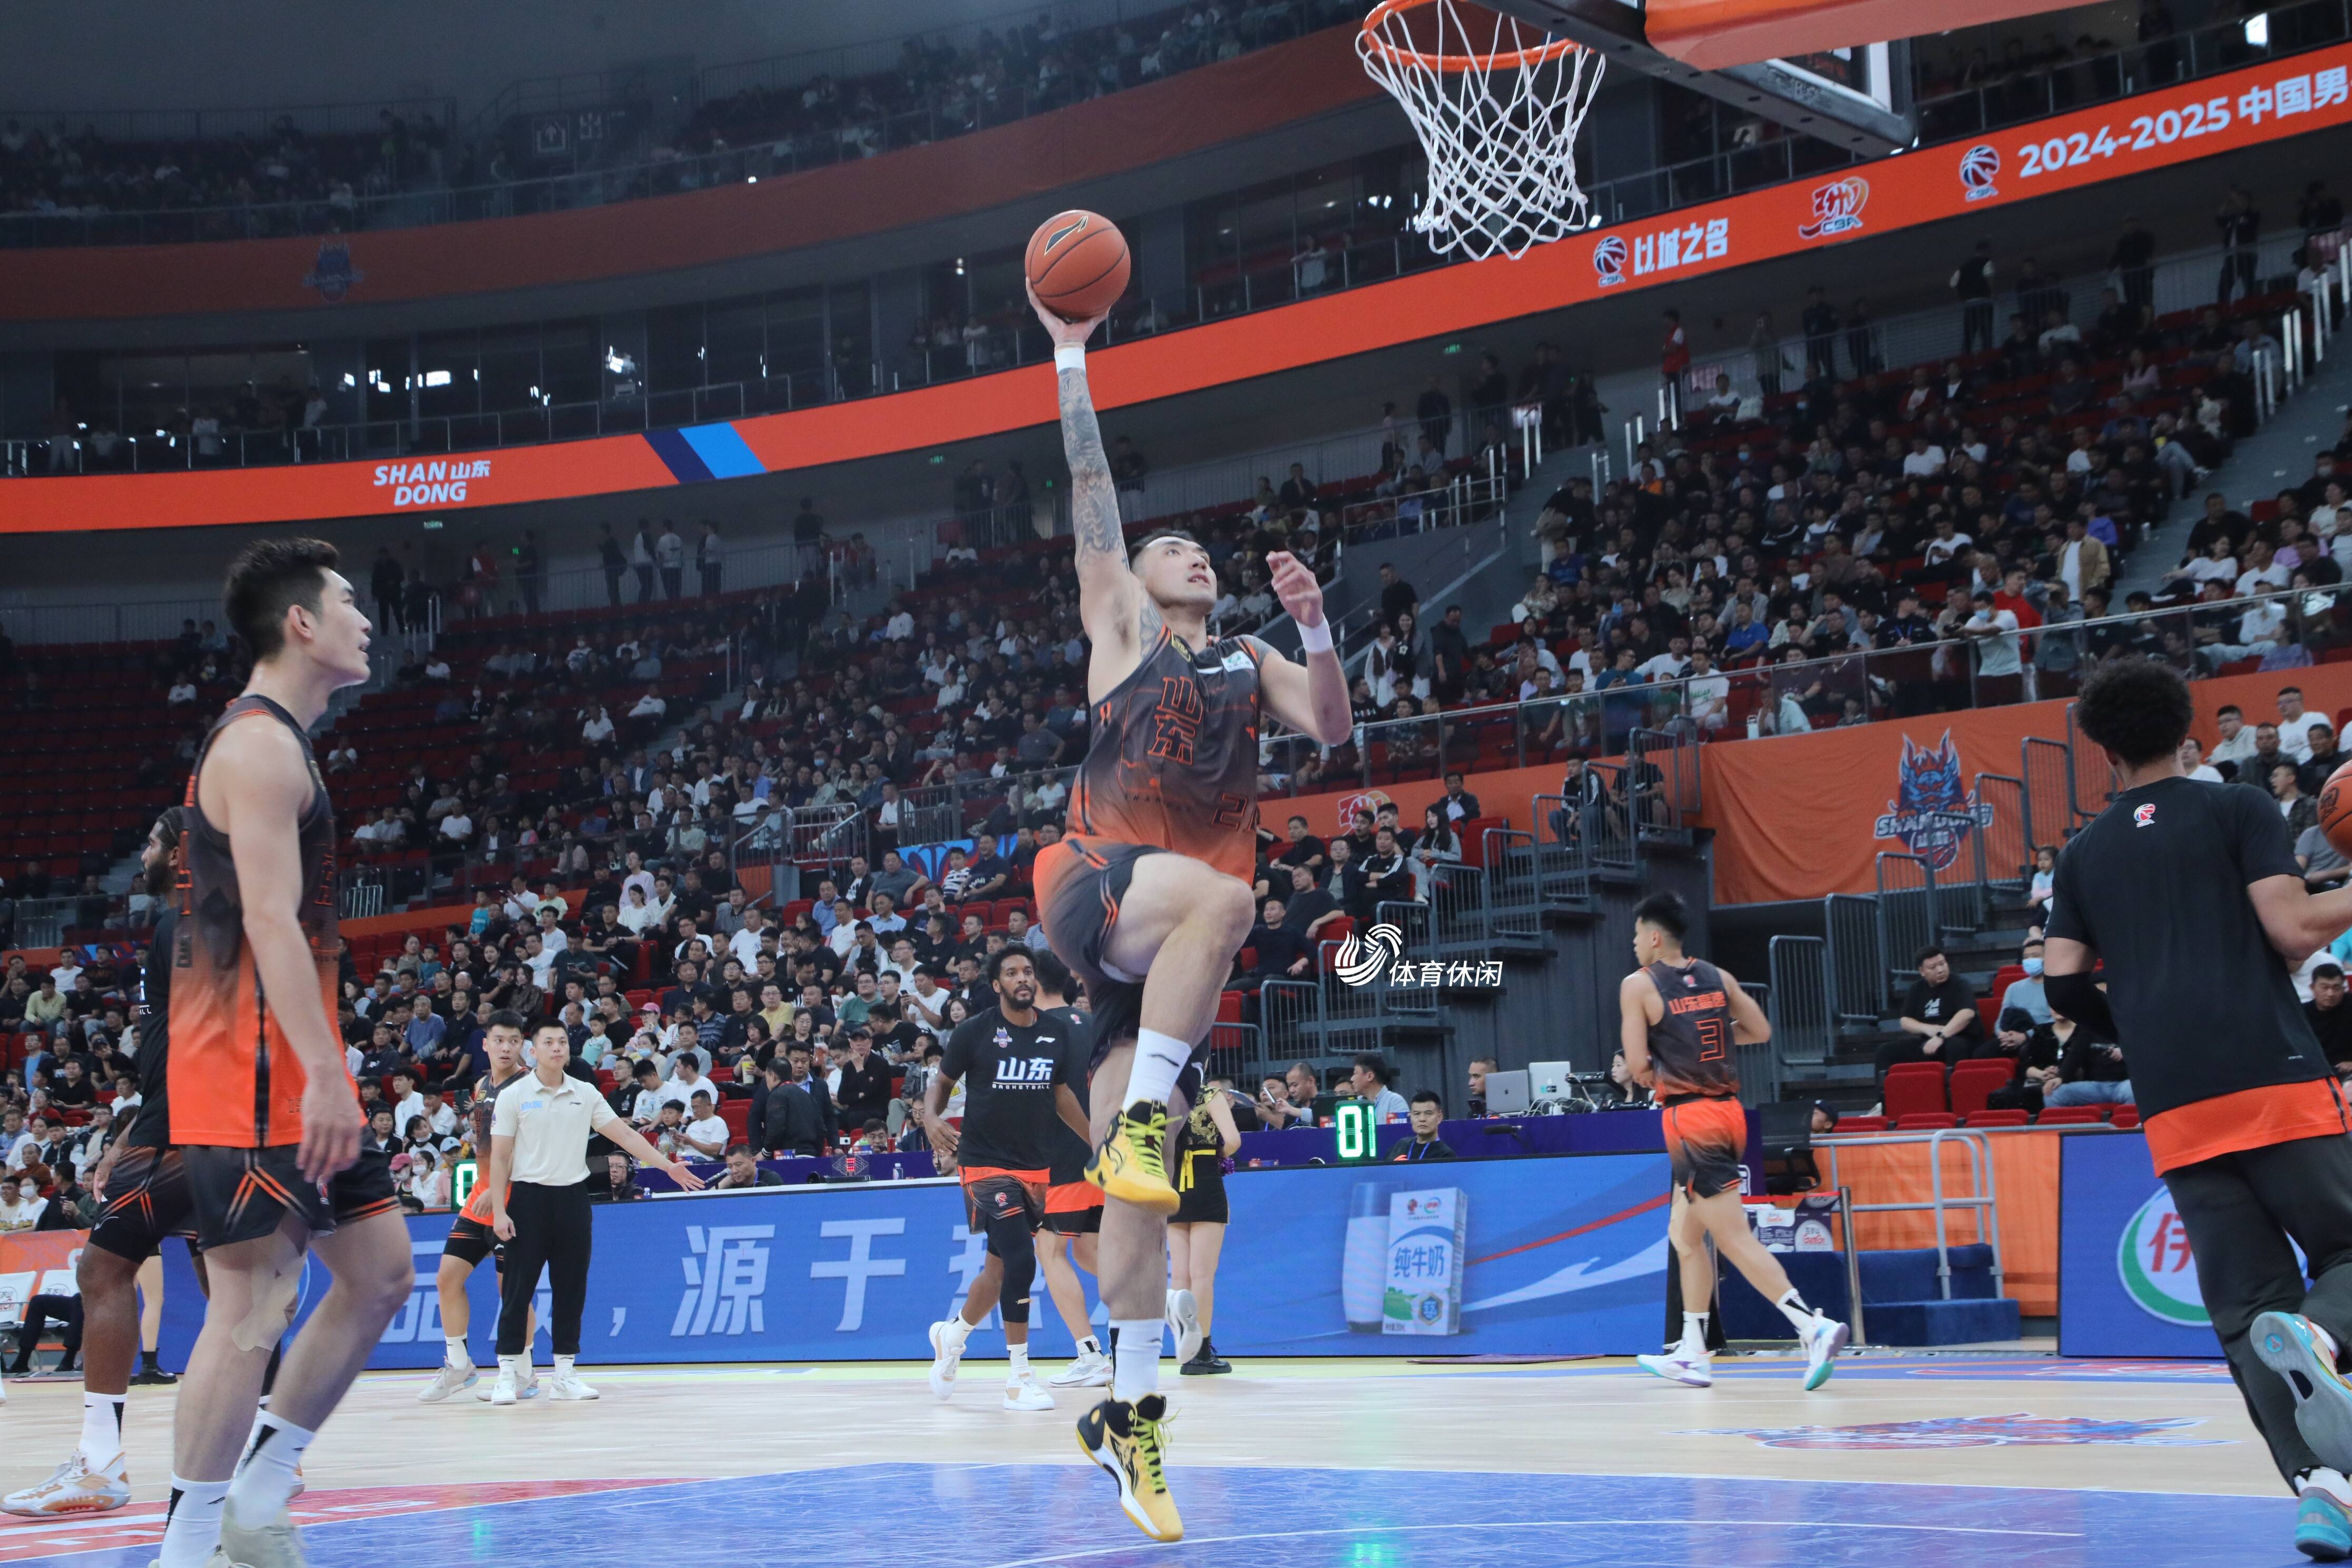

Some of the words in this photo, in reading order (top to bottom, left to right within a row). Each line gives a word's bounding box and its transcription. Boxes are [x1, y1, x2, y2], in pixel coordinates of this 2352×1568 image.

[2017, 96, 2230, 178] 2024-2025
[2238, 65, 2352, 125] 中国男
[1821, 215, 1863, 235] CBA
[1634, 218, 1728, 276] 以城之名
[374, 461, 446, 486] SHAN
[450, 459, 491, 480] 山东
[394, 481, 467, 506] DONG
[1694, 1017, 1726, 1063] 3
[996, 1057, 1054, 1080] 山东
[1393, 1244, 1445, 1278] 纯牛奶
